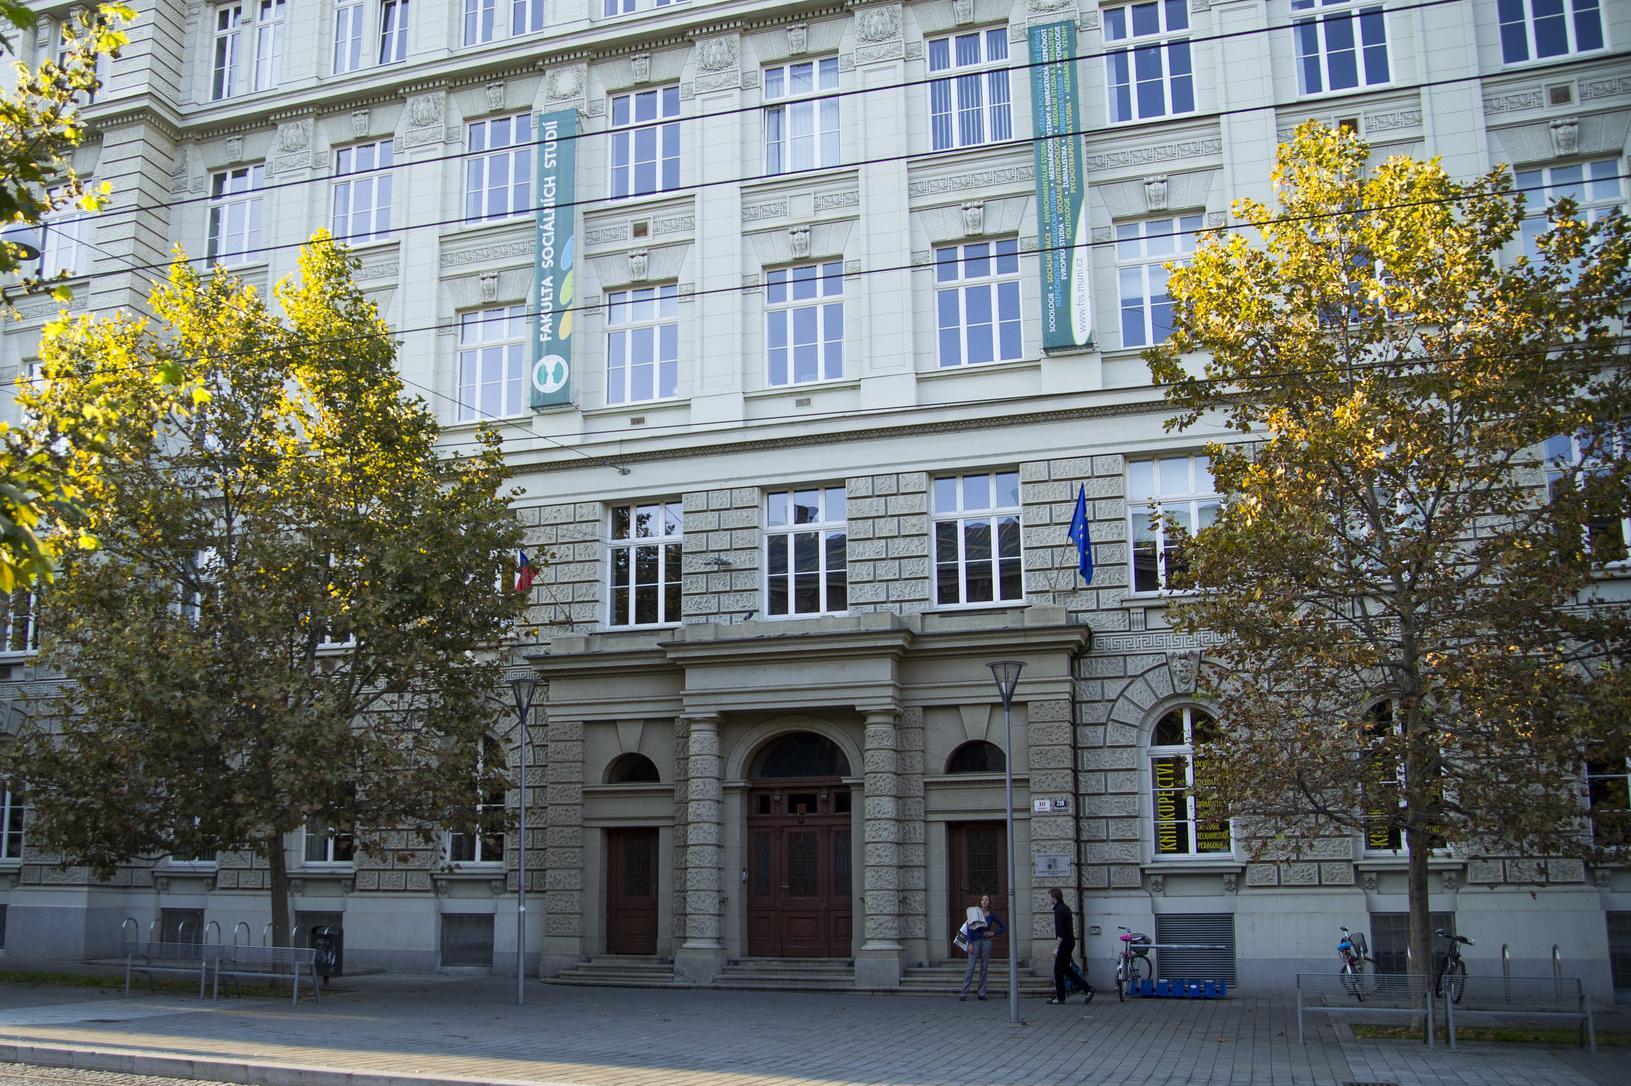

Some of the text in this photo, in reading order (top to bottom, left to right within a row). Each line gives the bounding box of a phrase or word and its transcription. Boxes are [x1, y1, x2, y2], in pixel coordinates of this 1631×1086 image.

[1048, 27, 1056, 68] ŽRNALISTIKA
[1047, 137, 1055, 180] MEZINÁRODN
[1060, 145, 1069, 188] ŽURNALISTIKA
[1066, 124, 1076, 192] PSYCHOTERAPEUTIKÁ
[1041, 165, 1050, 223] ENVIRONMENTÁLNÍ
[540, 120, 558, 342] FAKULTA SOCIÁLNÍCH STUDIÍ
[1050, 213, 1058, 254] SRATEGICKÁ
[1053, 260, 1061, 307] BEZPEČNOSTNÍ
[1076, 258, 1087, 333] www.fss.muni.cz
[1154, 763, 1176, 850] KNIHKUPECTVÍ
